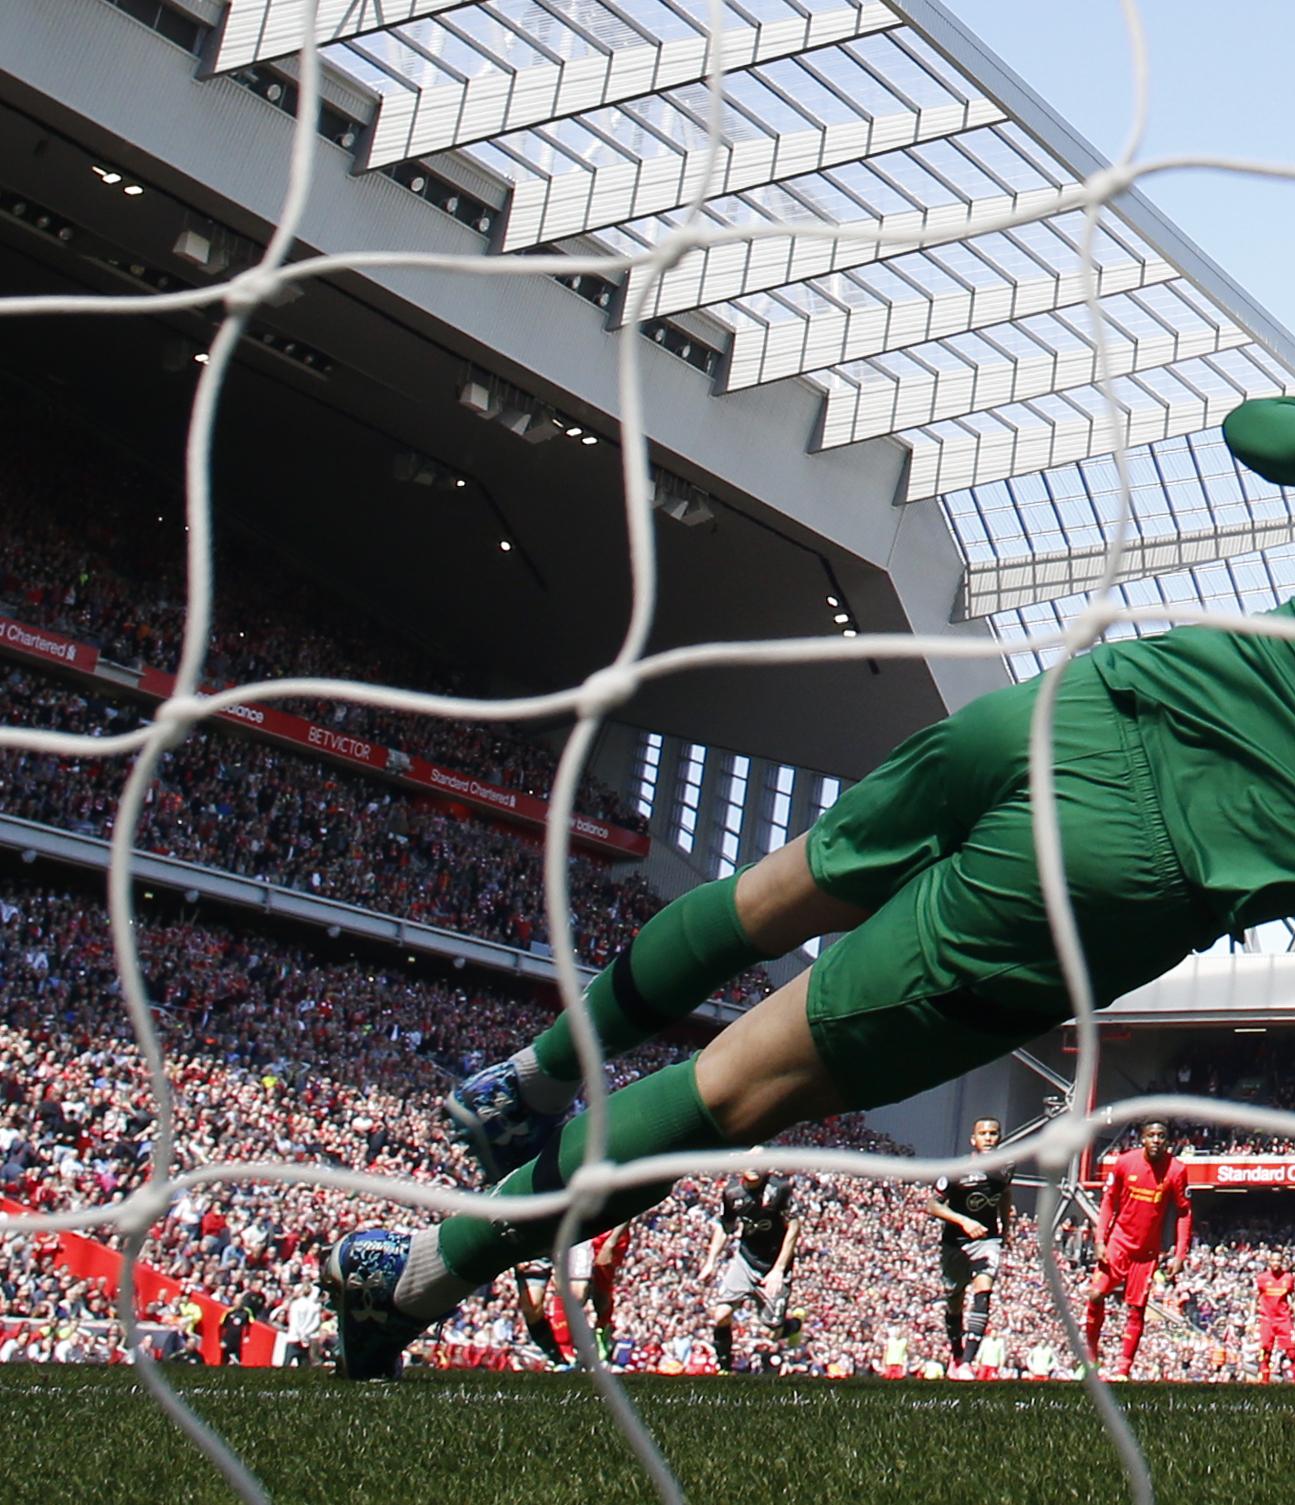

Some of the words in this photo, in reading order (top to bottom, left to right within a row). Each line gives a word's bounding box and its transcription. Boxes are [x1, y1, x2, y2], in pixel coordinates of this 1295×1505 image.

[7, 624, 67, 658] Chartered
[307, 725, 372, 760] BETVICTOR
[430, 768, 469, 793] Standard
[1217, 1164, 1285, 1182] Standard
